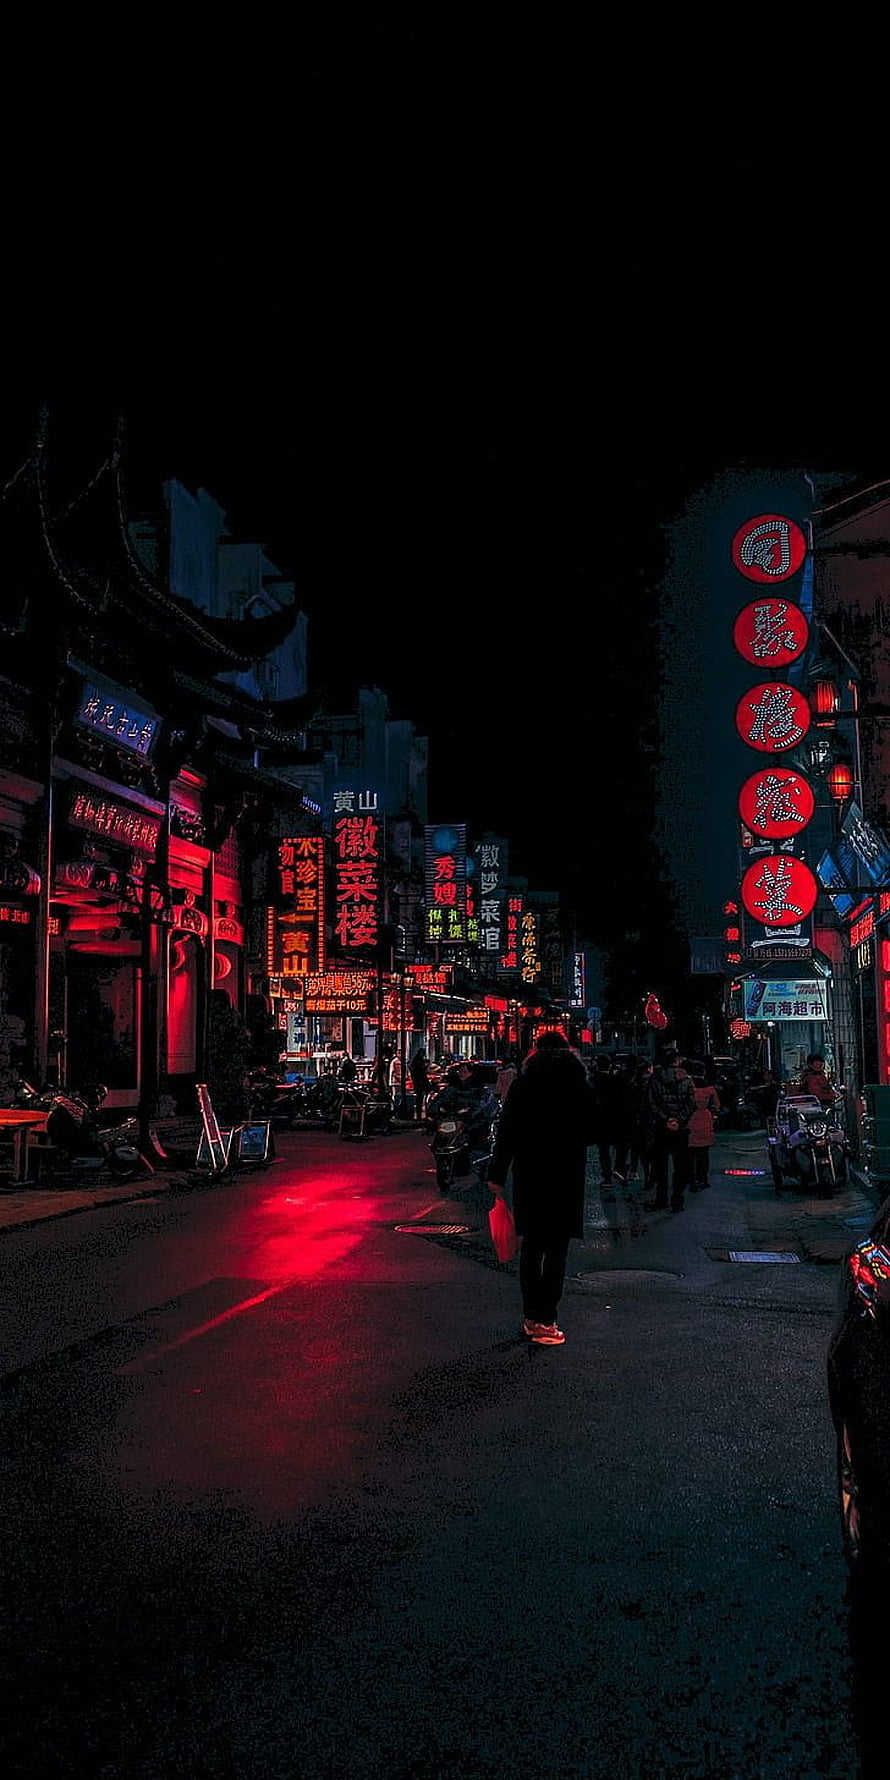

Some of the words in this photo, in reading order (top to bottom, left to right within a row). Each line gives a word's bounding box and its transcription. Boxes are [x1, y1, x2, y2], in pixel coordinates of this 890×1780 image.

[333, 790, 378, 812] 黄山
[335, 816, 378, 946] 徽菜楼
[433, 855, 457, 905] 秀嫂
[282, 931, 310, 974] 黄山
[763, 1001, 823, 1016] 阿海超市
